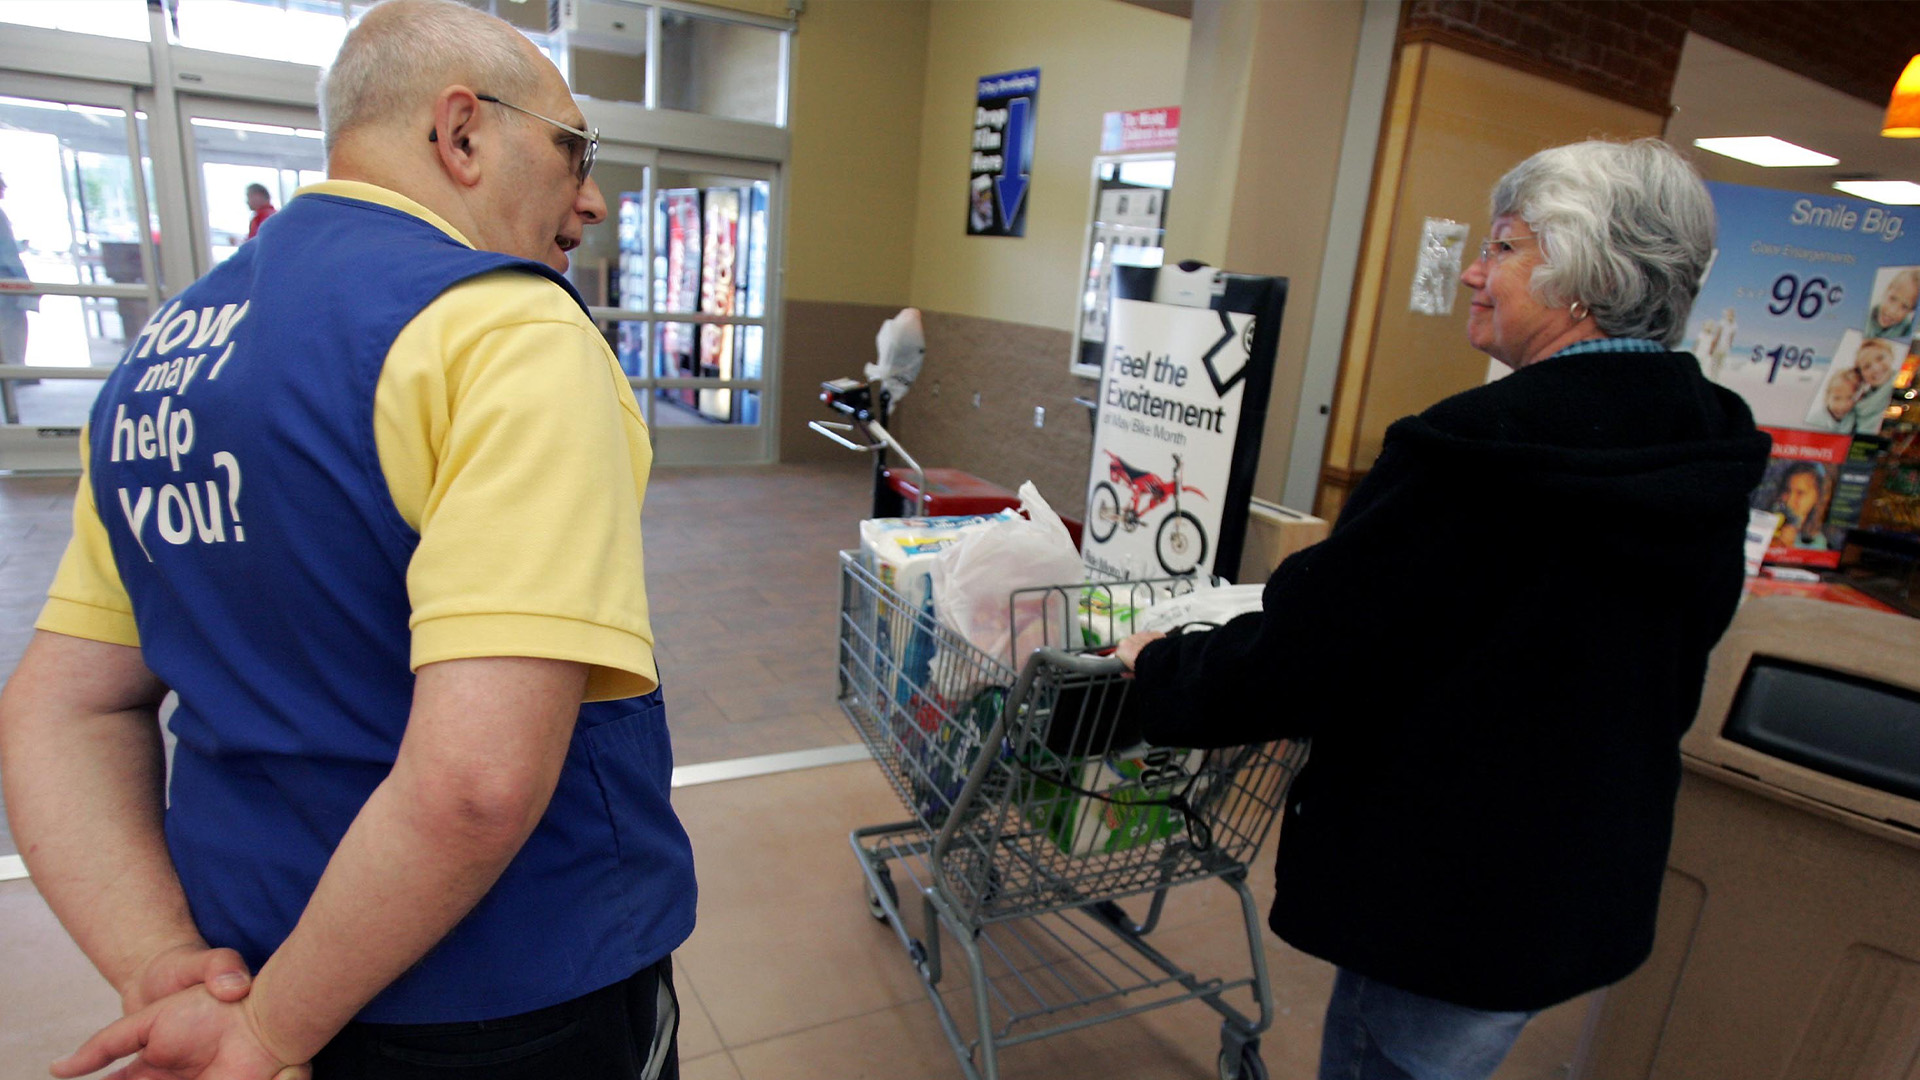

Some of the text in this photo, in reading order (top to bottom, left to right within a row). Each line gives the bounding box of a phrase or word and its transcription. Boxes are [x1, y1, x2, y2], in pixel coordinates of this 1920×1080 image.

[973, 127, 1002, 150] Film
[975, 107, 1008, 131] Drop
[971, 151, 1003, 172] Here
[1790, 198, 1905, 242] Smile Big.
[123, 300, 250, 365] How
[134, 341, 236, 396] may I
[1110, 345, 1188, 388] Feel the
[1106, 378, 1226, 434] Excitement
[111, 395, 196, 472] help
[1153, 424, 1188, 446] Month
[1771, 442, 1799, 456] OLOR
[117, 450, 246, 563] you?
